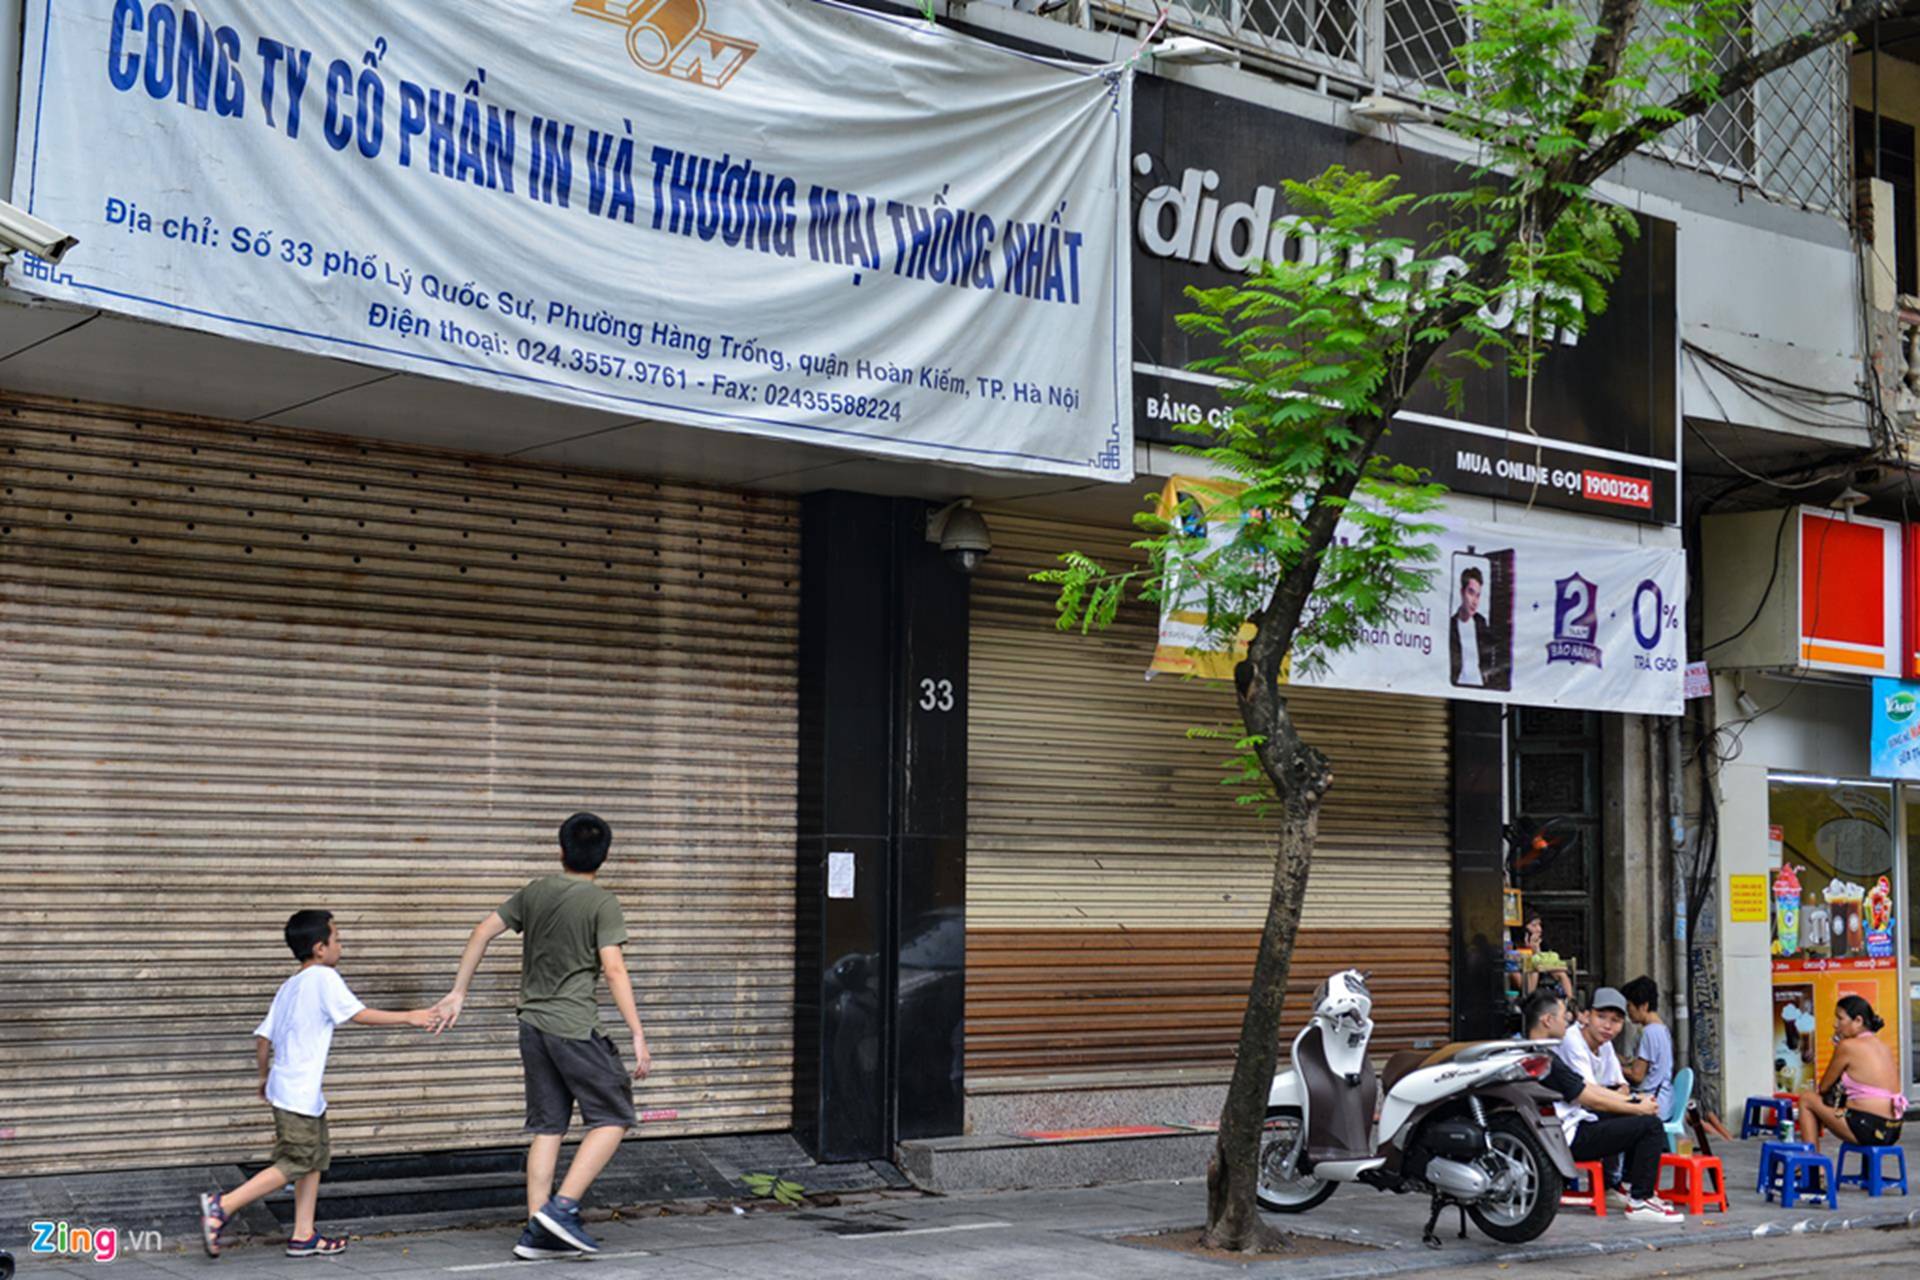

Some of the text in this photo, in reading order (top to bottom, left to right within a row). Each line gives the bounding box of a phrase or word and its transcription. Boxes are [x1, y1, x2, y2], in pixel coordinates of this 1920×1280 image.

[257, 36, 311, 139] TY
[324, 36, 388, 159] CỔ
[399, 67, 516, 194] PHẦN
[529, 115, 575, 208] IN
[587, 118, 635, 224] VÀ
[651, 145, 797, 258] THƯƠNG
[808, 184, 881, 286] MẠI
[886, 183, 996, 290] THỐNG
[1003, 201, 1083, 305] NHẤT
[105, 197, 1080, 413] Địa chỉ: Số 33 phố Lý Quốc Sư, Phường Hàng Trống, quận Hoàn Kiếm, TP. Hà Nội
[368, 302, 431, 339] Điện
[439, 320, 509, 357] thoại:
[516, 338, 688, 390] 024.3557.9761
[711, 374, 757, 402] Fax:
[764, 384, 902, 422] 02435588224
[1146, 393, 1203, 425] BẢNG
[1457, 451, 1650, 503] MUA ONLINE GỌI 19001234
[1562, 579, 1590, 639] 2
[1394, 629, 1433, 655] dung
[1634, 652, 1652, 671] TRẢ
[919, 678, 954, 711] 33
